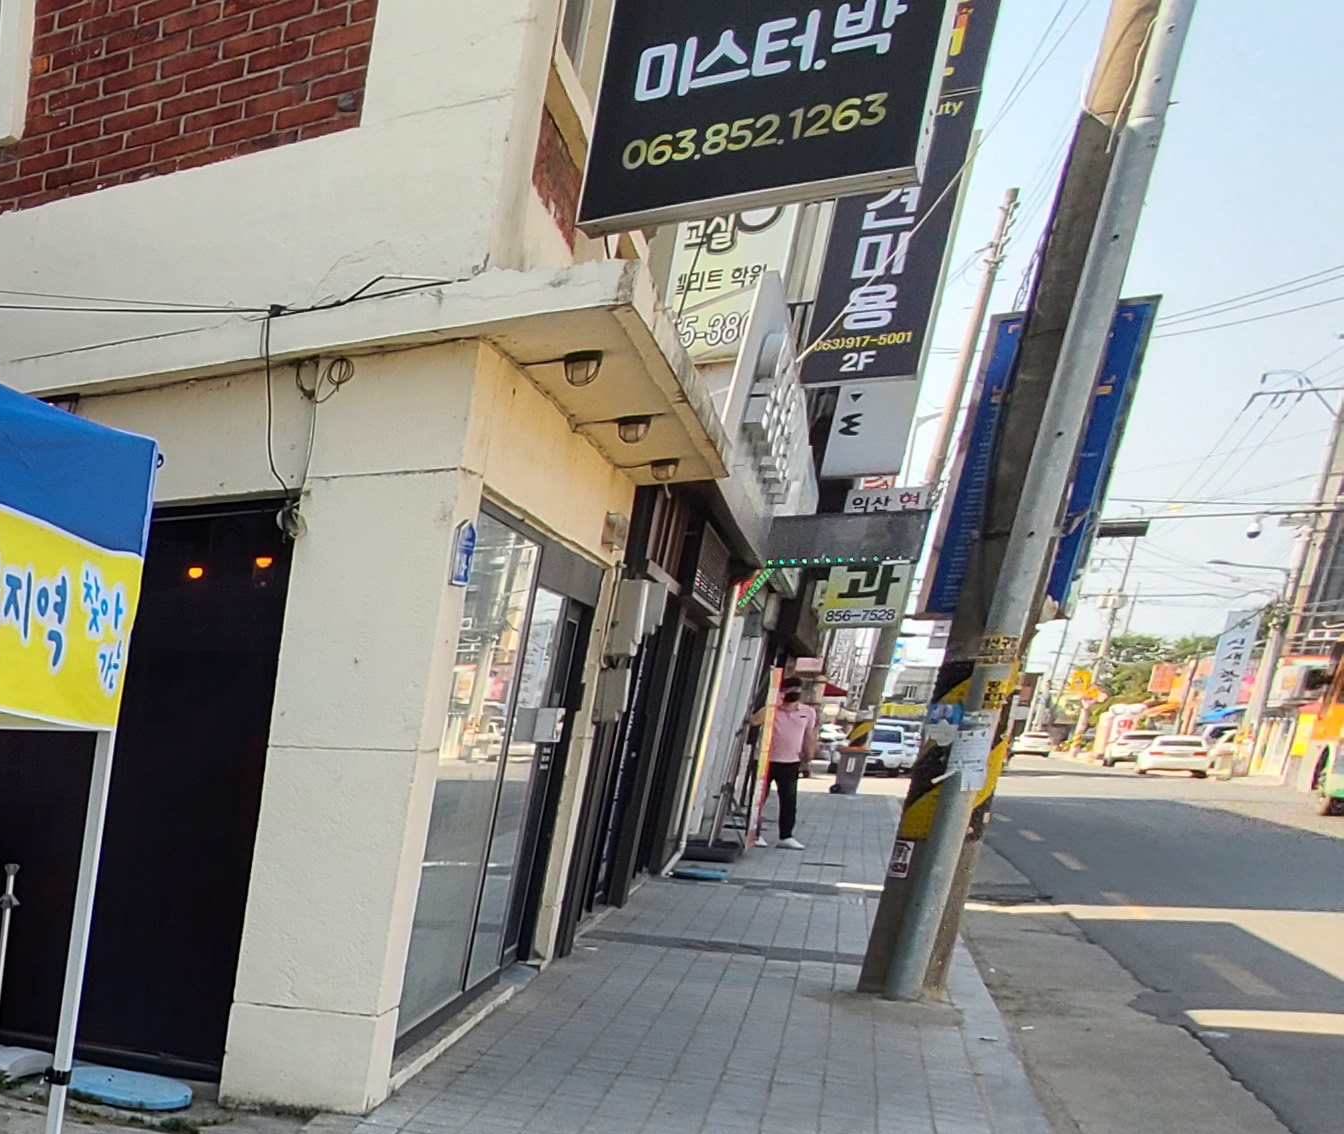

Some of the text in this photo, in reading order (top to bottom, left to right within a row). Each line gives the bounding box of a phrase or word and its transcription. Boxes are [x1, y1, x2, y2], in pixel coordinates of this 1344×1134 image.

[634, 0, 908, 101] 미스터.박
[621, 92, 889, 171] 063.852.1263
[839, 350, 877, 372] 2F
[852, 496, 891, 514] 익산
[825, 608, 896, 622] 856-7528
